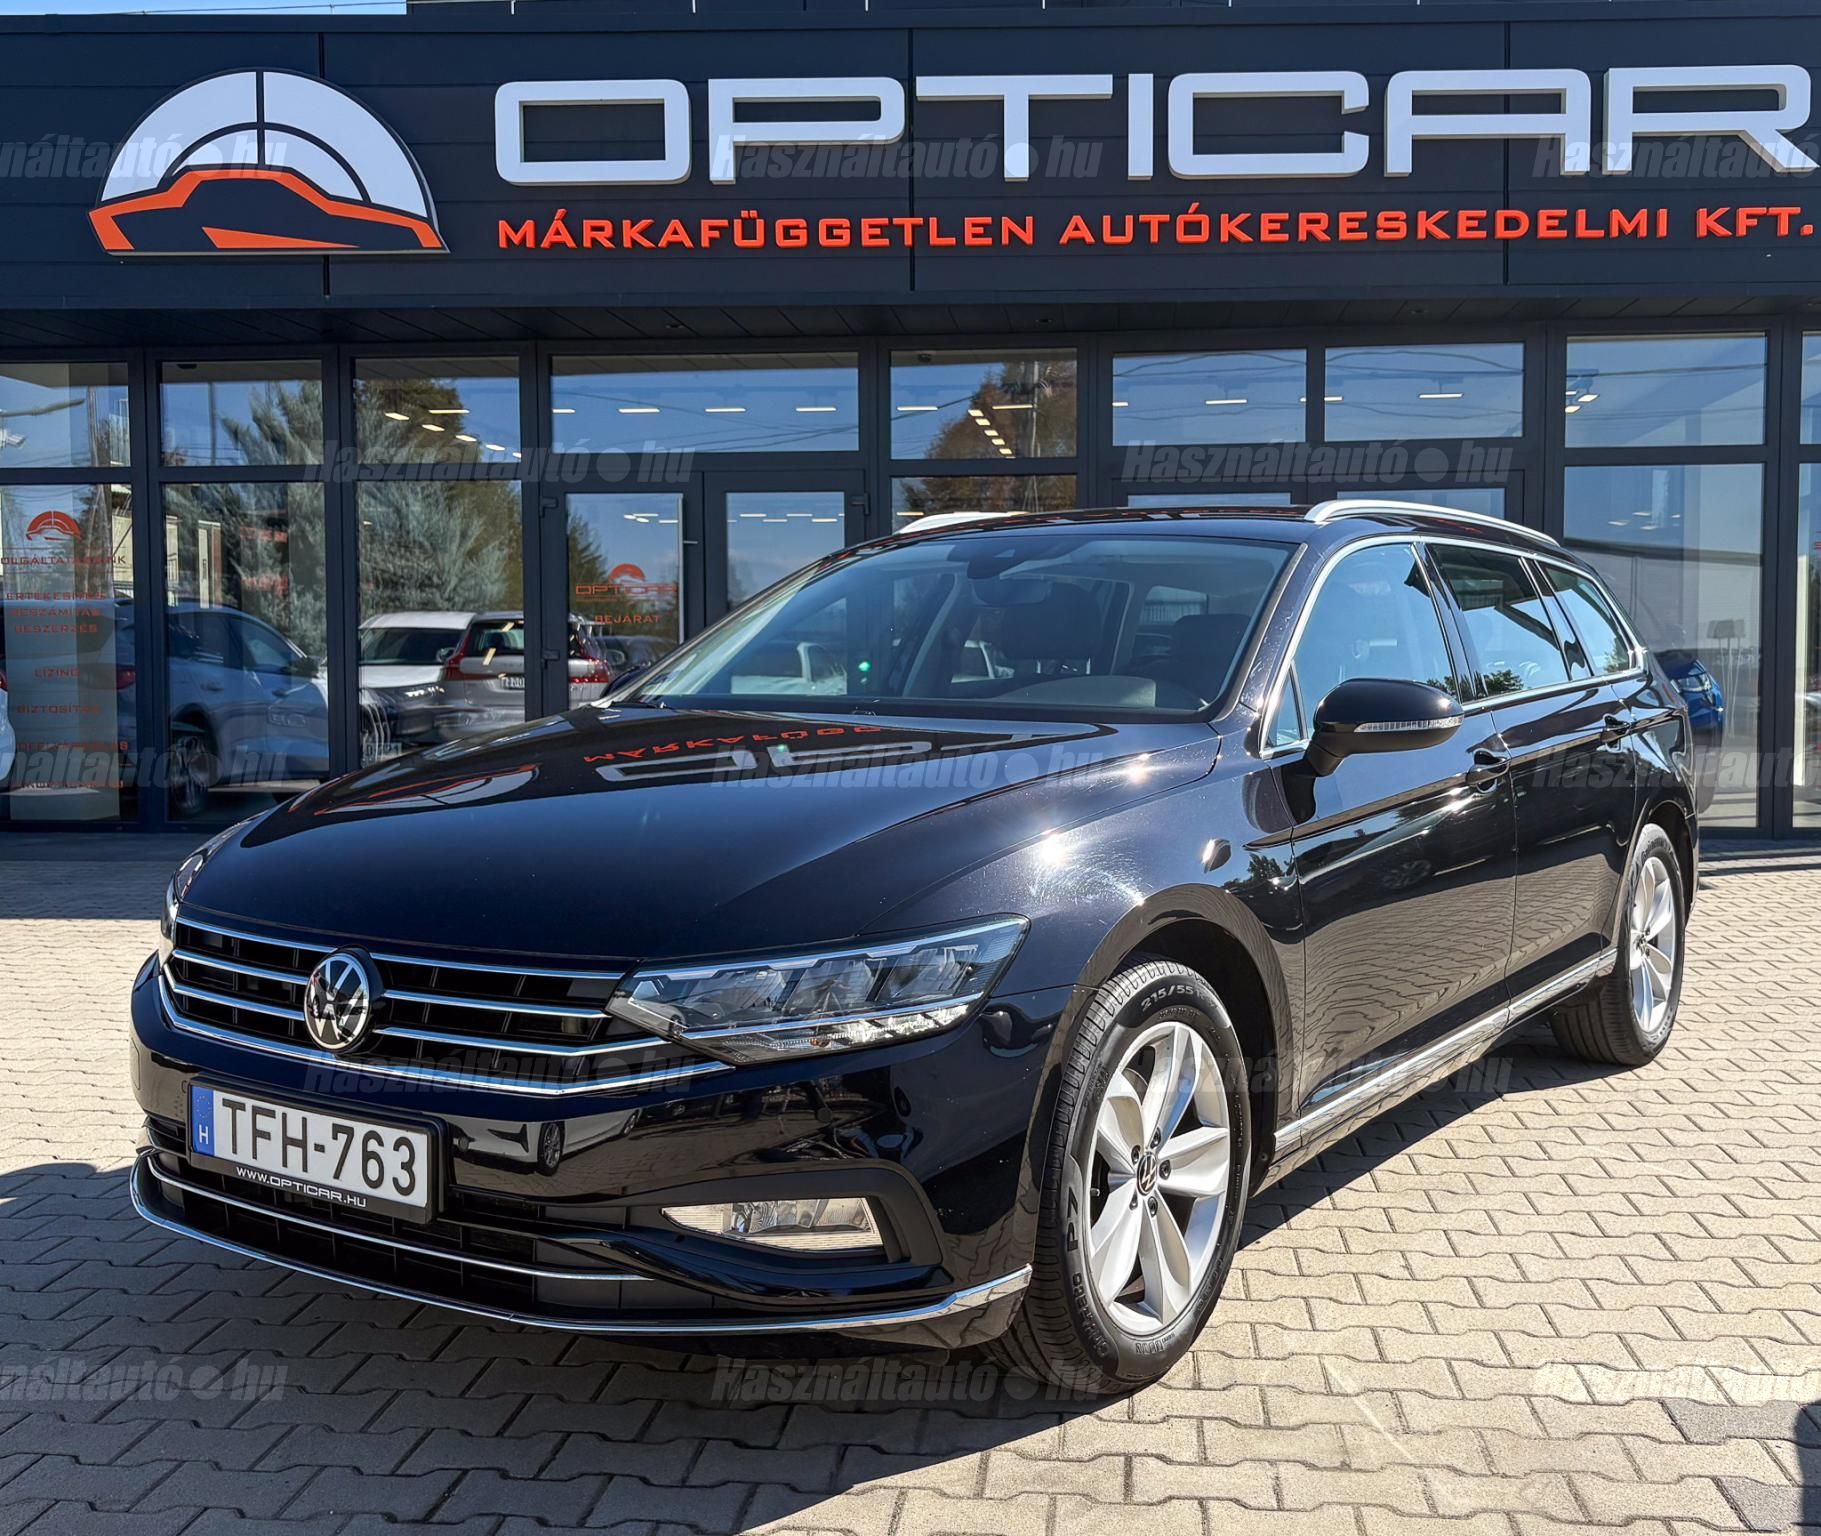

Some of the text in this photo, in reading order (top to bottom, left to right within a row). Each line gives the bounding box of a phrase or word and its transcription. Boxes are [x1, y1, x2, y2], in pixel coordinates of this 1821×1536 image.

[494, 65, 1821, 186] OPTICAR
[497, 203, 1814, 249] MÁRKAFÜGGETLEN AUTÓKERESKEDELMI KFT.
[199, 1098, 416, 1197] H TFH-763
[236, 1166, 366, 1208] WWW.OPTICAR.HU
